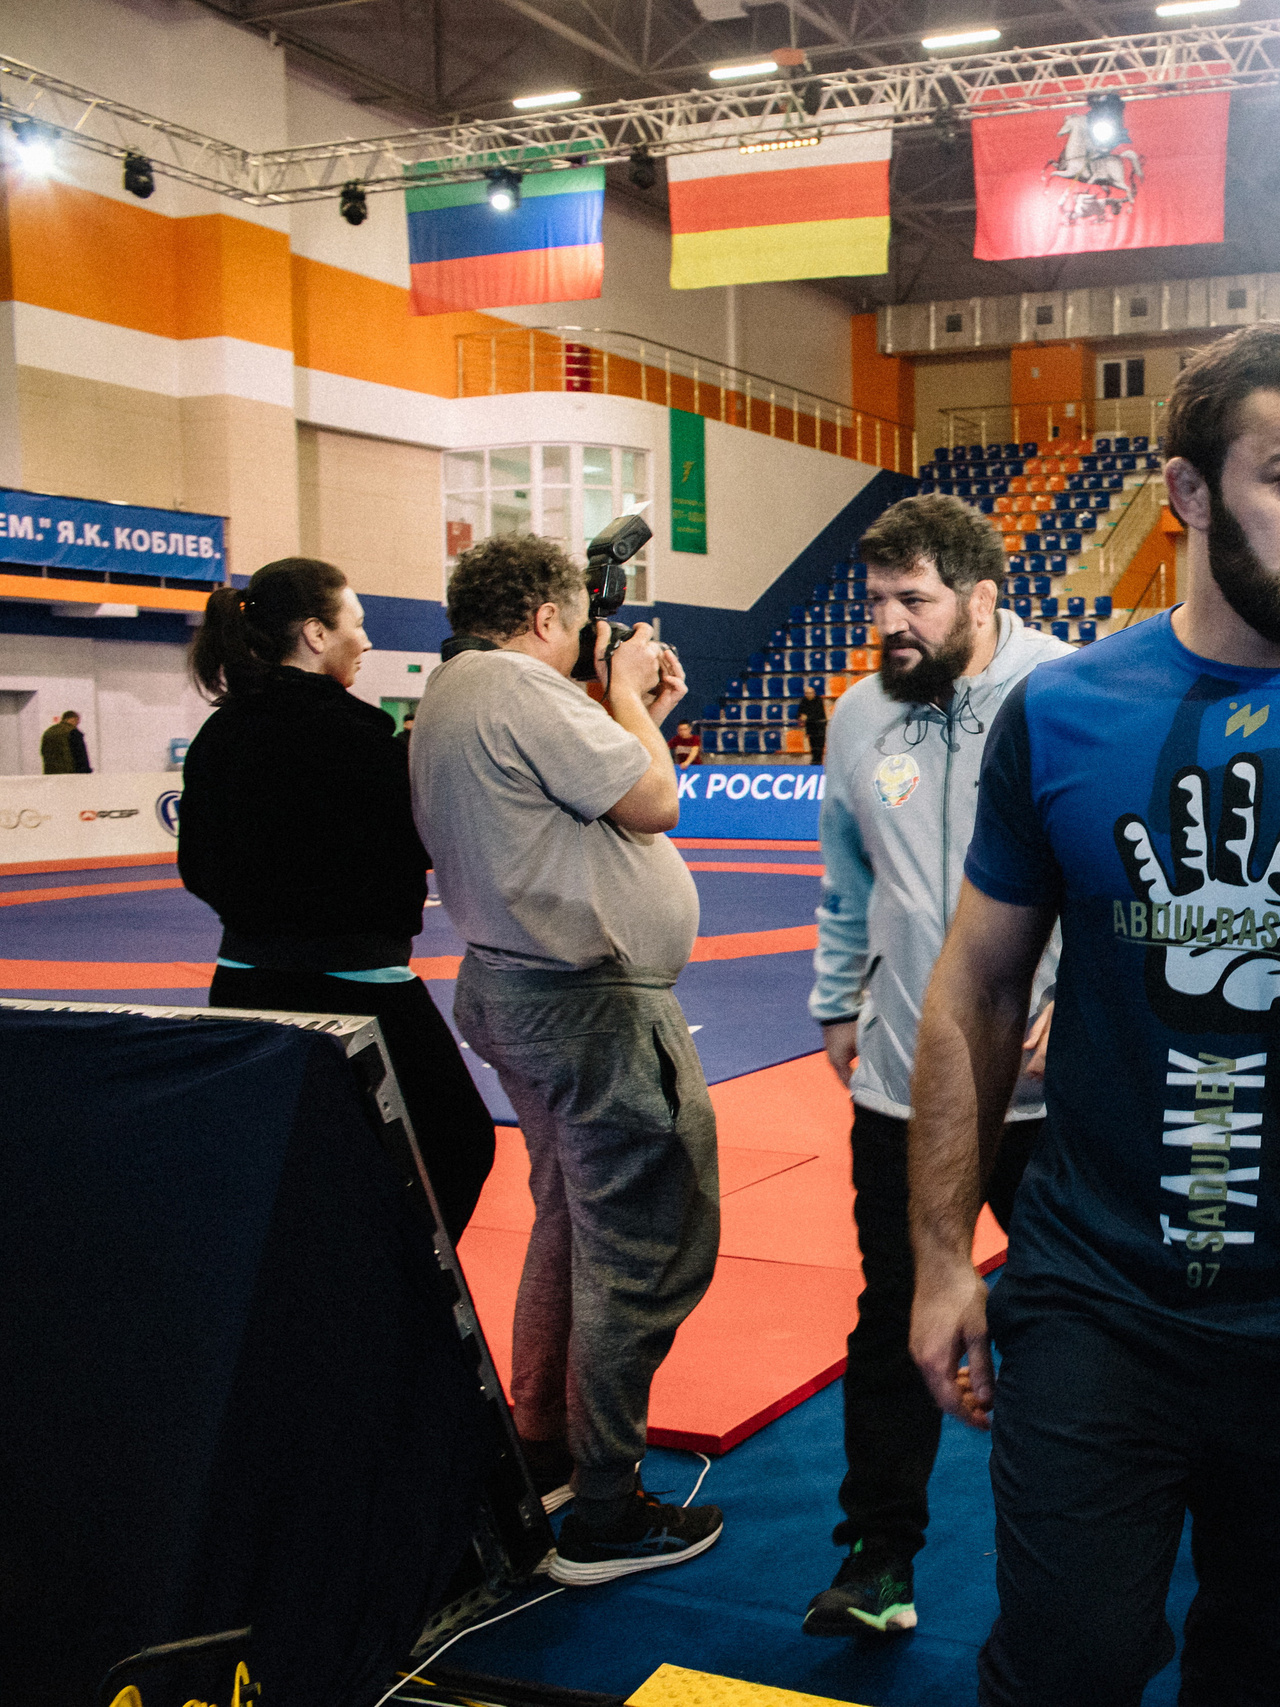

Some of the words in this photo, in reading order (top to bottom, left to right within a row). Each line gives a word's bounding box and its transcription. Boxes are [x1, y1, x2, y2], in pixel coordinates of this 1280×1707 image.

[56, 520, 110, 549] Я.К.
[113, 526, 222, 560] КОБЛЕВ.
[1159, 1048, 1268, 1246] TANK
[1185, 1051, 1237, 1253] SADULAEV
[1186, 1261, 1221, 1289] 97
